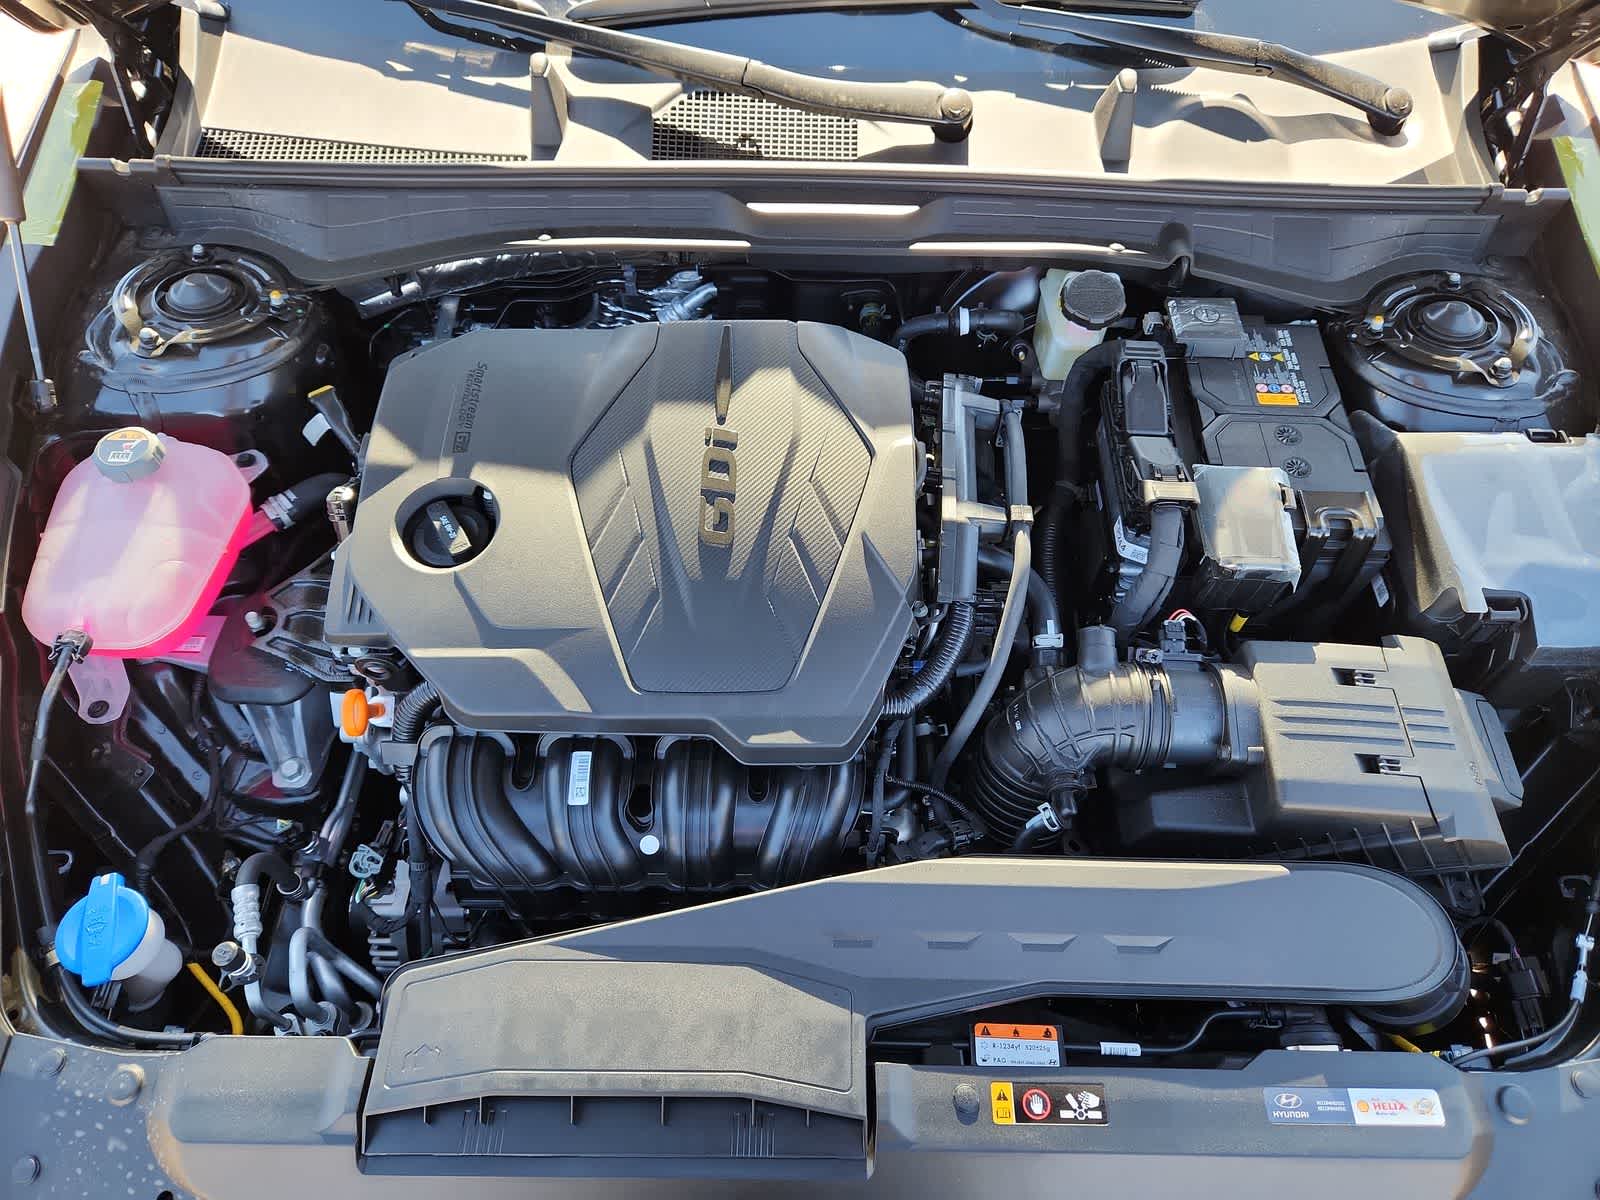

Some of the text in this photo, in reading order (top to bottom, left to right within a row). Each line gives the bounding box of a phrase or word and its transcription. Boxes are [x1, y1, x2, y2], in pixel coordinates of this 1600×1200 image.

[464, 361, 488, 430] Smartstream
[1373, 1103, 1409, 1111] HELIX
[1273, 1111, 1310, 1119] HYUNDAI
